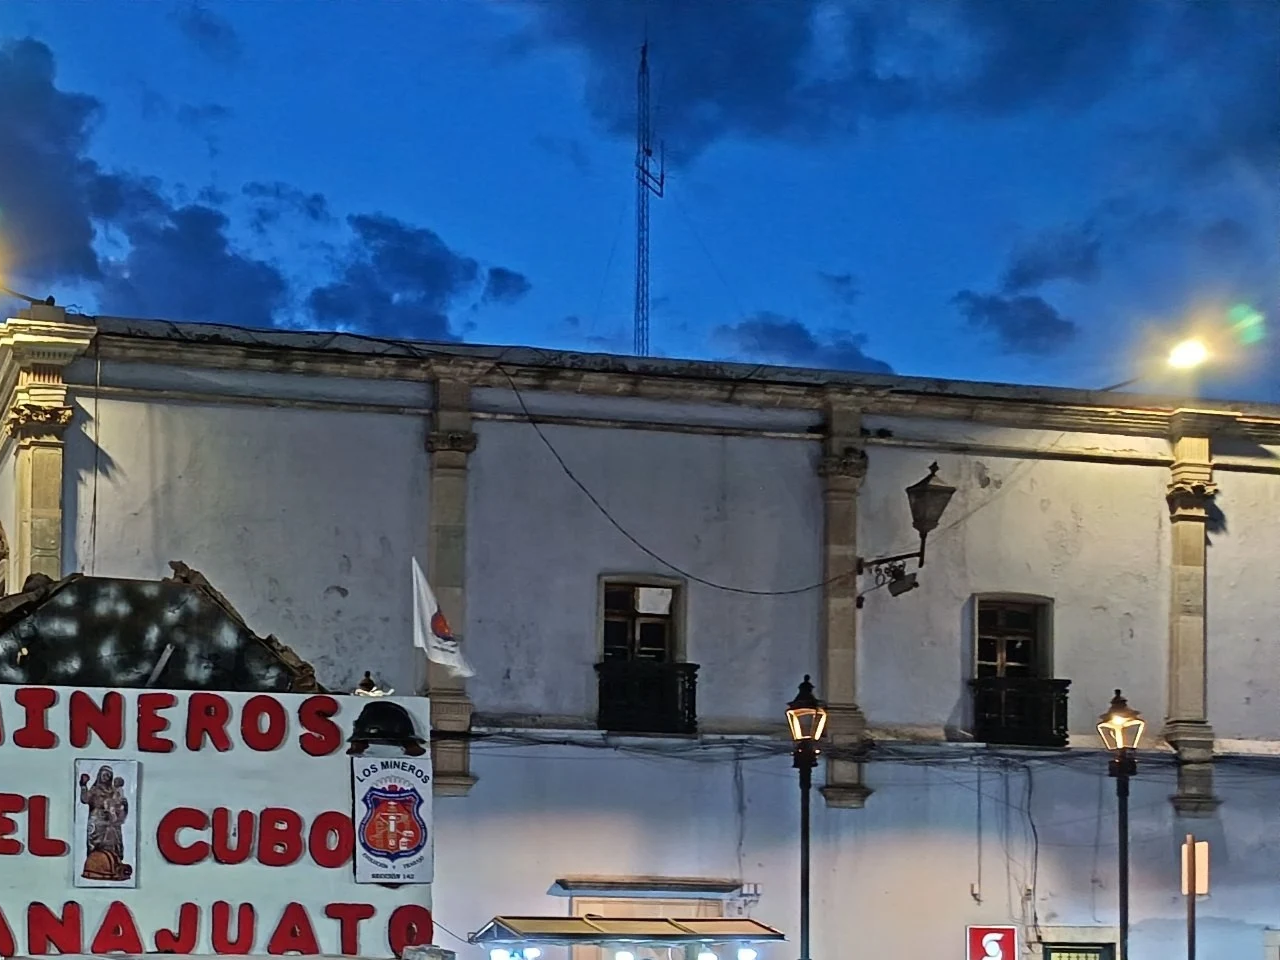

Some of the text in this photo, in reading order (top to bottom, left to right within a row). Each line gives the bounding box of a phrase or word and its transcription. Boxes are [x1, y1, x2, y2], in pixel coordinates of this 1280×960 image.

[356, 760, 431, 784] LOS MINEROS
[156, 806, 356, 869] CUBO
